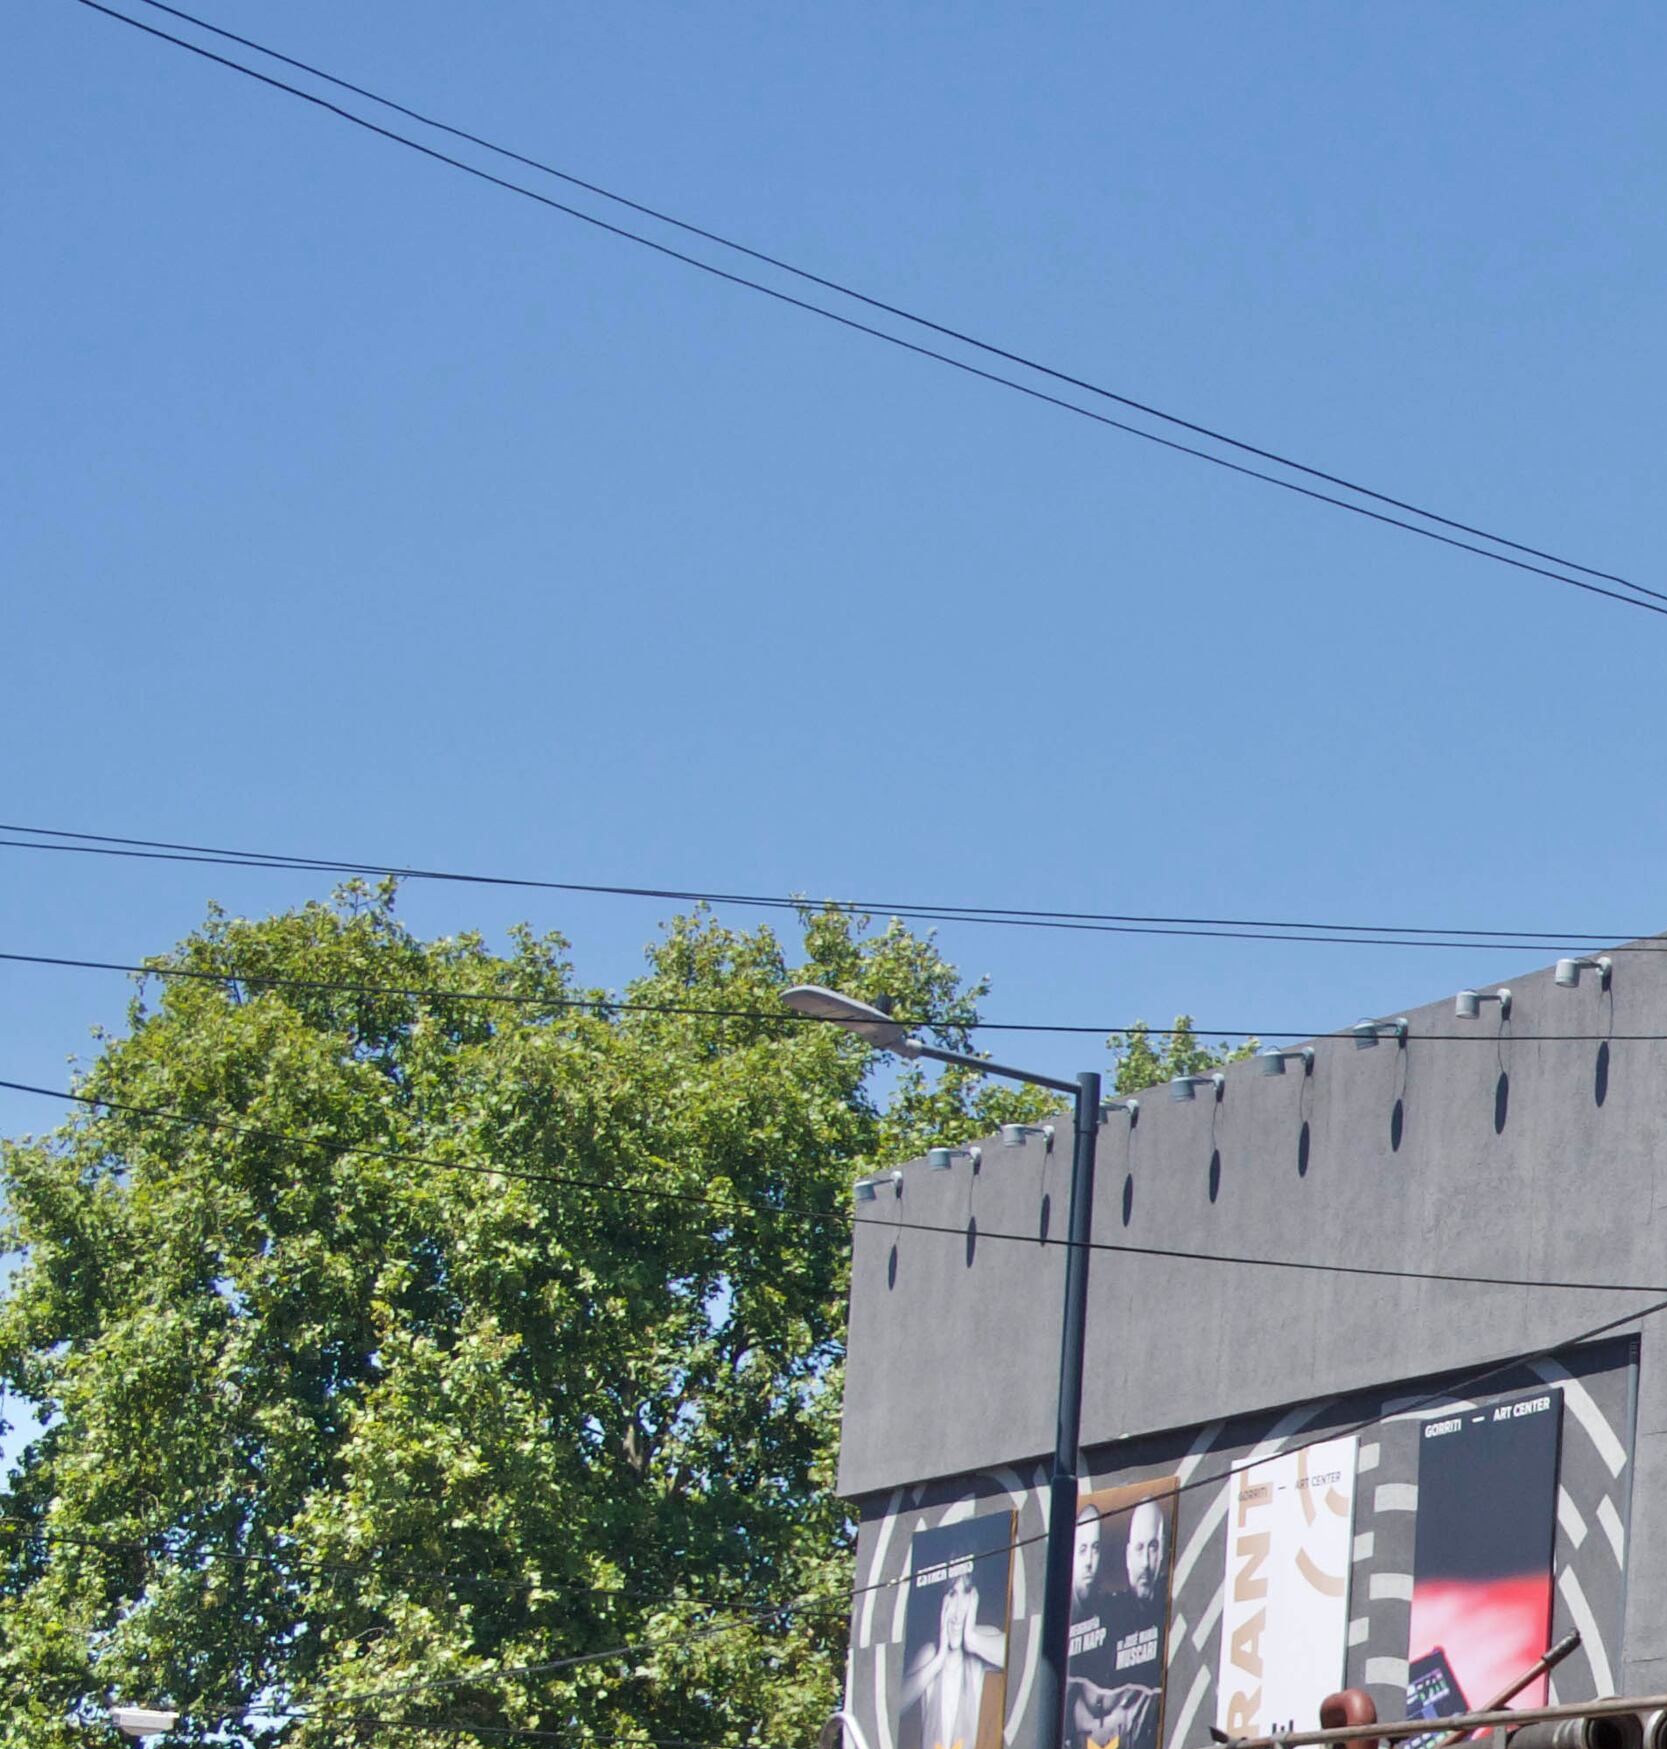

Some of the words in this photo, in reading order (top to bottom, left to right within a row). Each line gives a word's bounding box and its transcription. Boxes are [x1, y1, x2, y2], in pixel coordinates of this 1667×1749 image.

[1424, 1419, 1462, 1438] GORRITI
[1493, 1406, 1513, 1421] ART
[1513, 1397, 1550, 1417] CENTER
[1296, 1477, 1310, 1490] ART
[1311, 1470, 1342, 1487] CENTER
